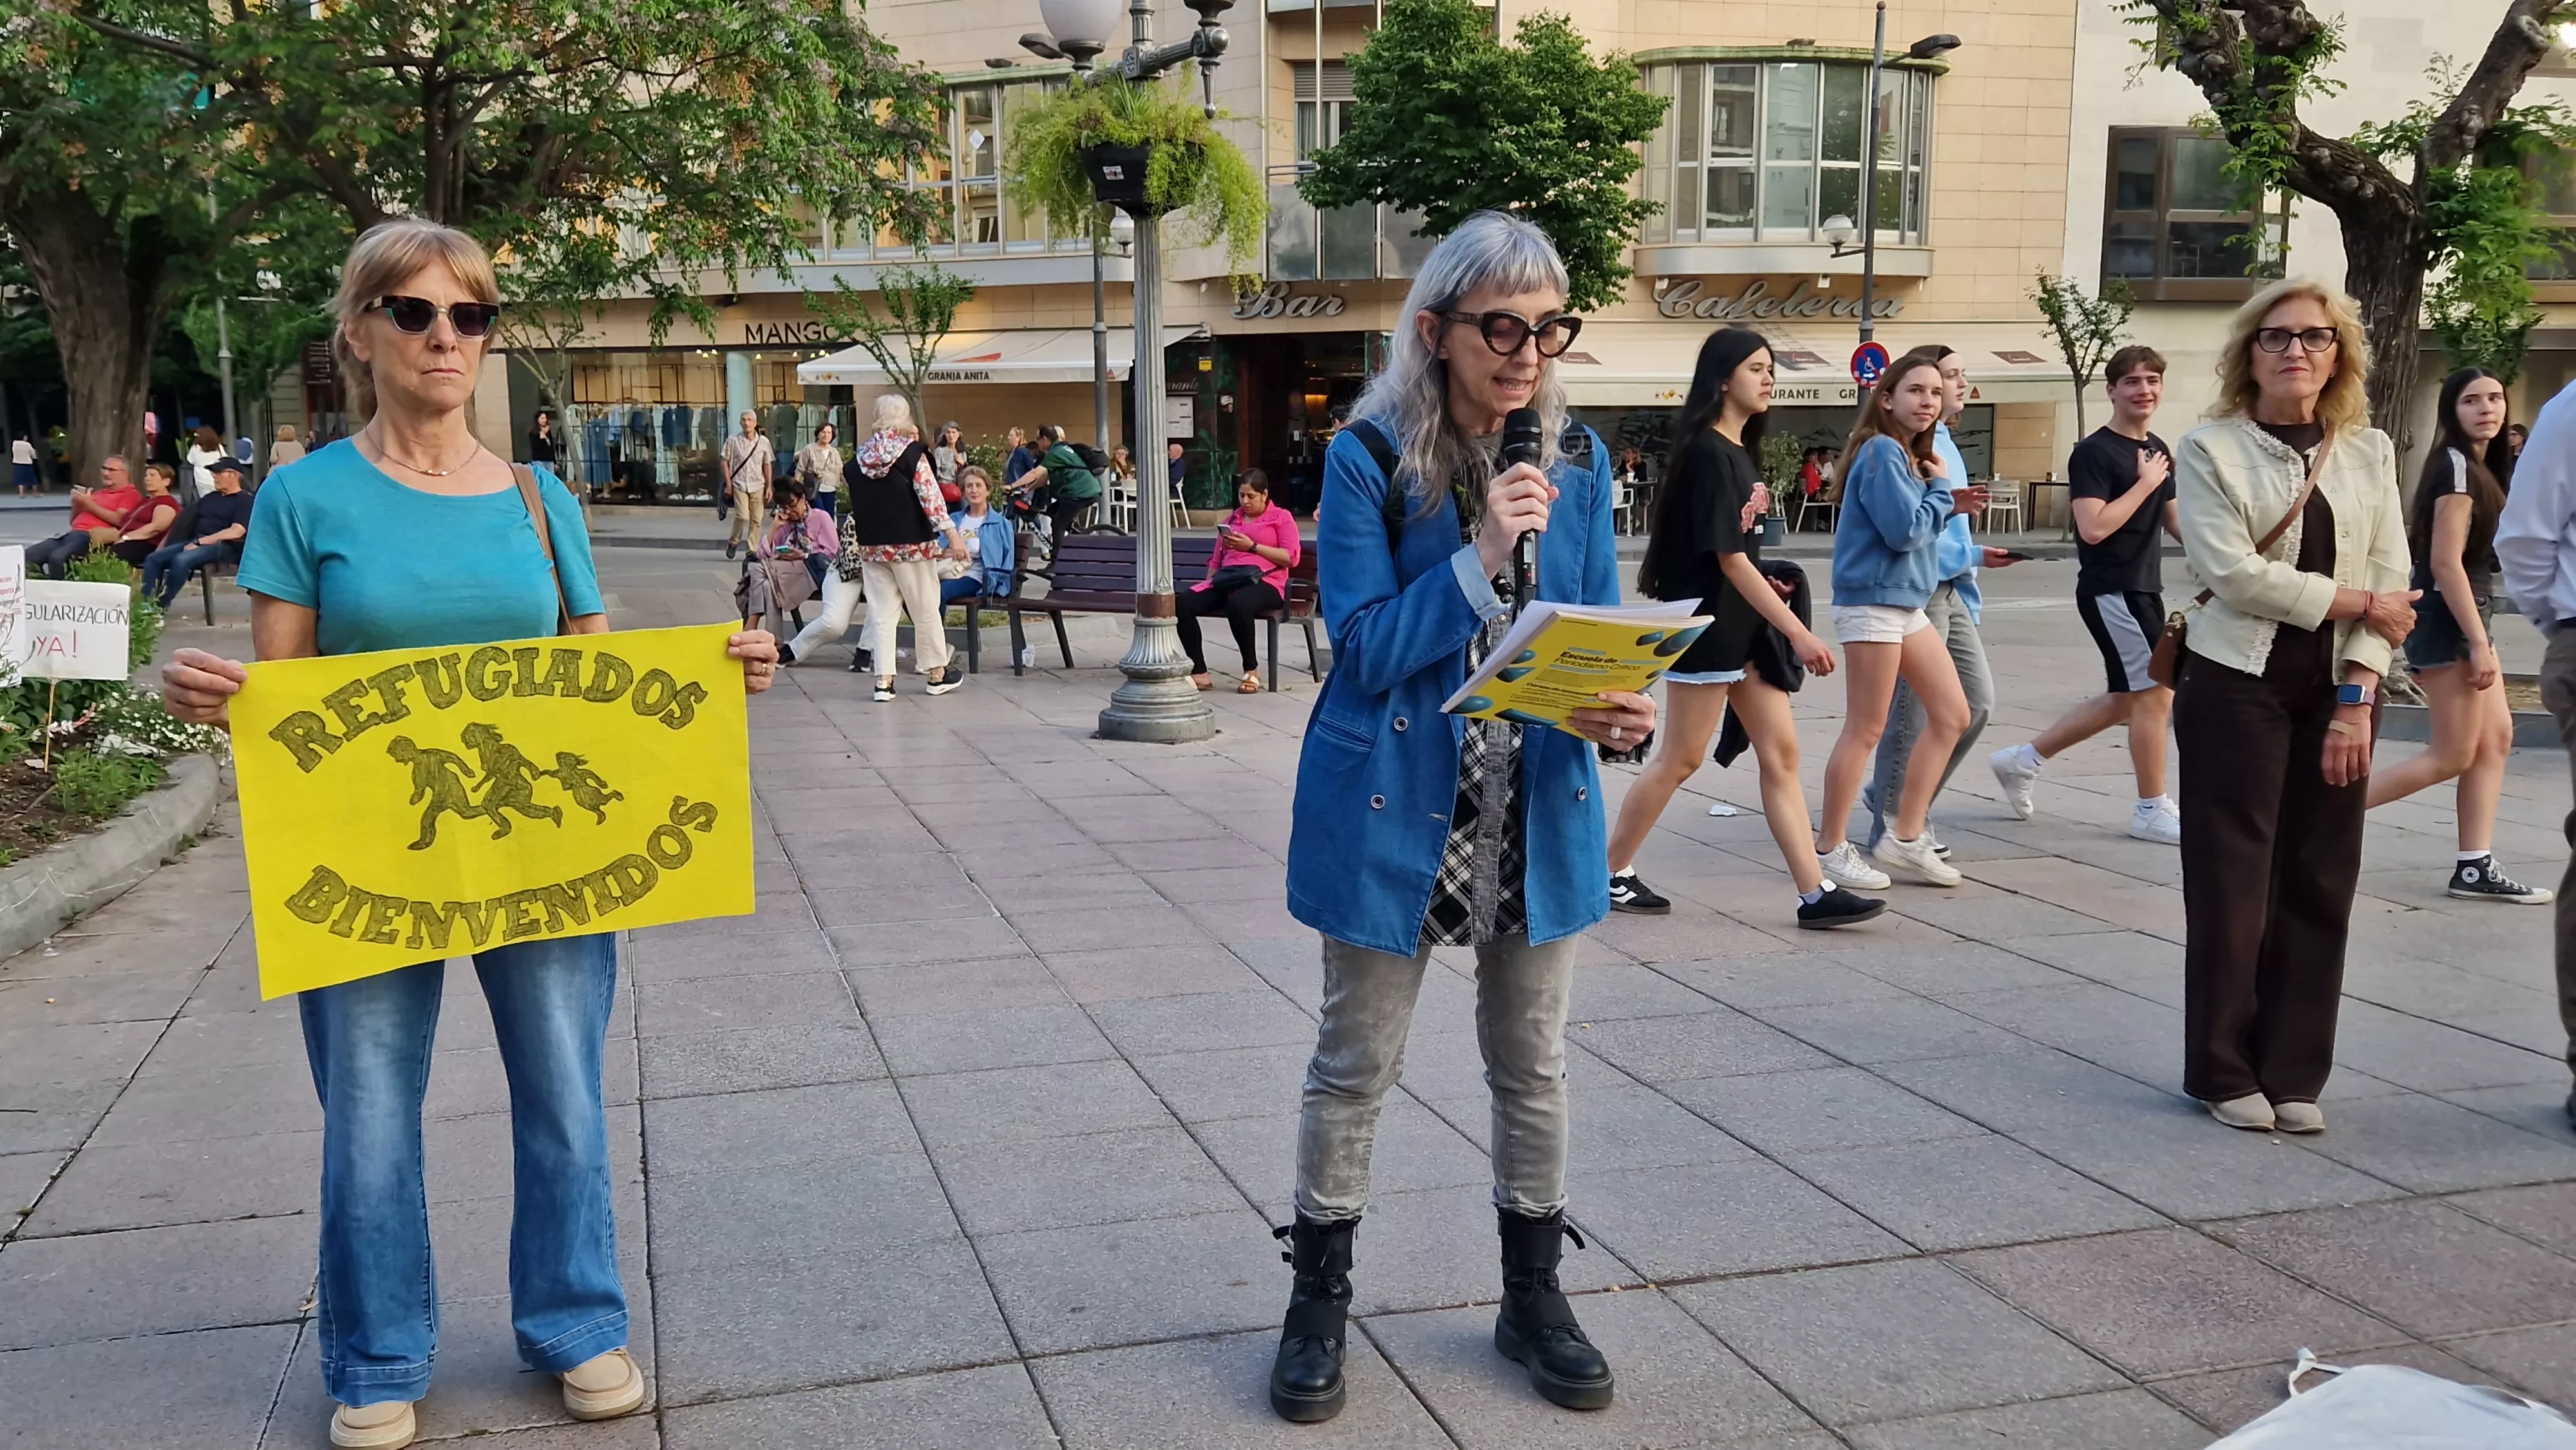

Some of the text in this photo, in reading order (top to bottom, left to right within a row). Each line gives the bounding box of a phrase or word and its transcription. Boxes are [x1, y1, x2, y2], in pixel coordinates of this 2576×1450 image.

[1230, 282, 1345, 319] Bar
[927, 371, 990, 381] GRANJA ANITA
[1770, 389, 1820, 399] URANTE
[25, 603, 129, 626] GULARIZACIÓN
[1553, 657, 1609, 670] Periodismo
[1560, 651, 1602, 663] Escuela
[269, 646, 708, 773] REFUGIADOS
[284, 795, 719, 950] BIENVENIDOS
